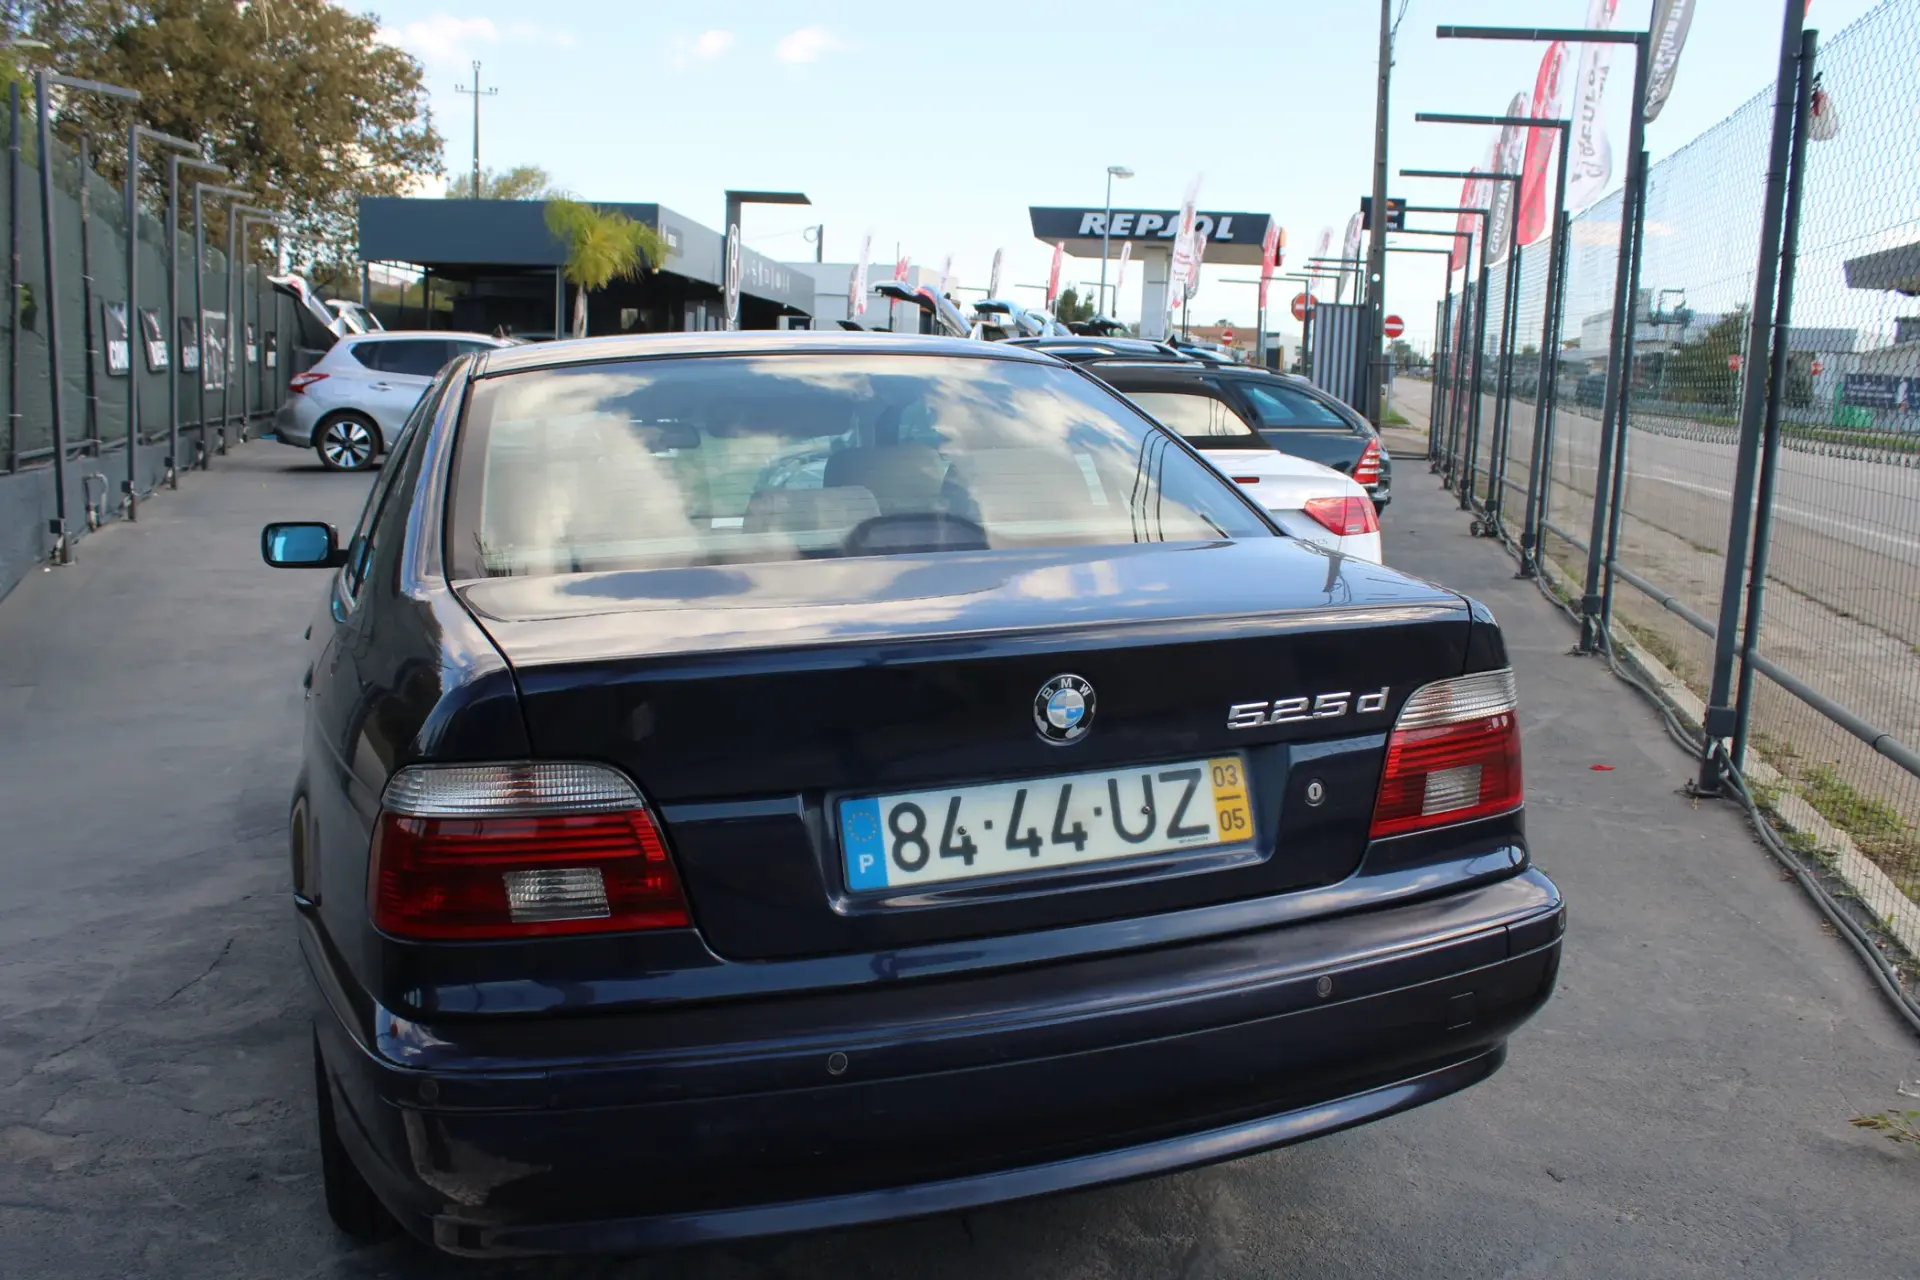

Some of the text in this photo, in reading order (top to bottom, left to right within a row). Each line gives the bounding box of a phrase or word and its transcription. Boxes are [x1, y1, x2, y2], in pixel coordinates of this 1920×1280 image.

[1491, 172, 1512, 254] CONFIAN
[1078, 212, 1235, 240] REPSOL
[1041, 677, 1091, 700] BMW
[1212, 764, 1239, 788] 03
[1219, 808, 1246, 832] 05
[859, 854, 875, 874] P
